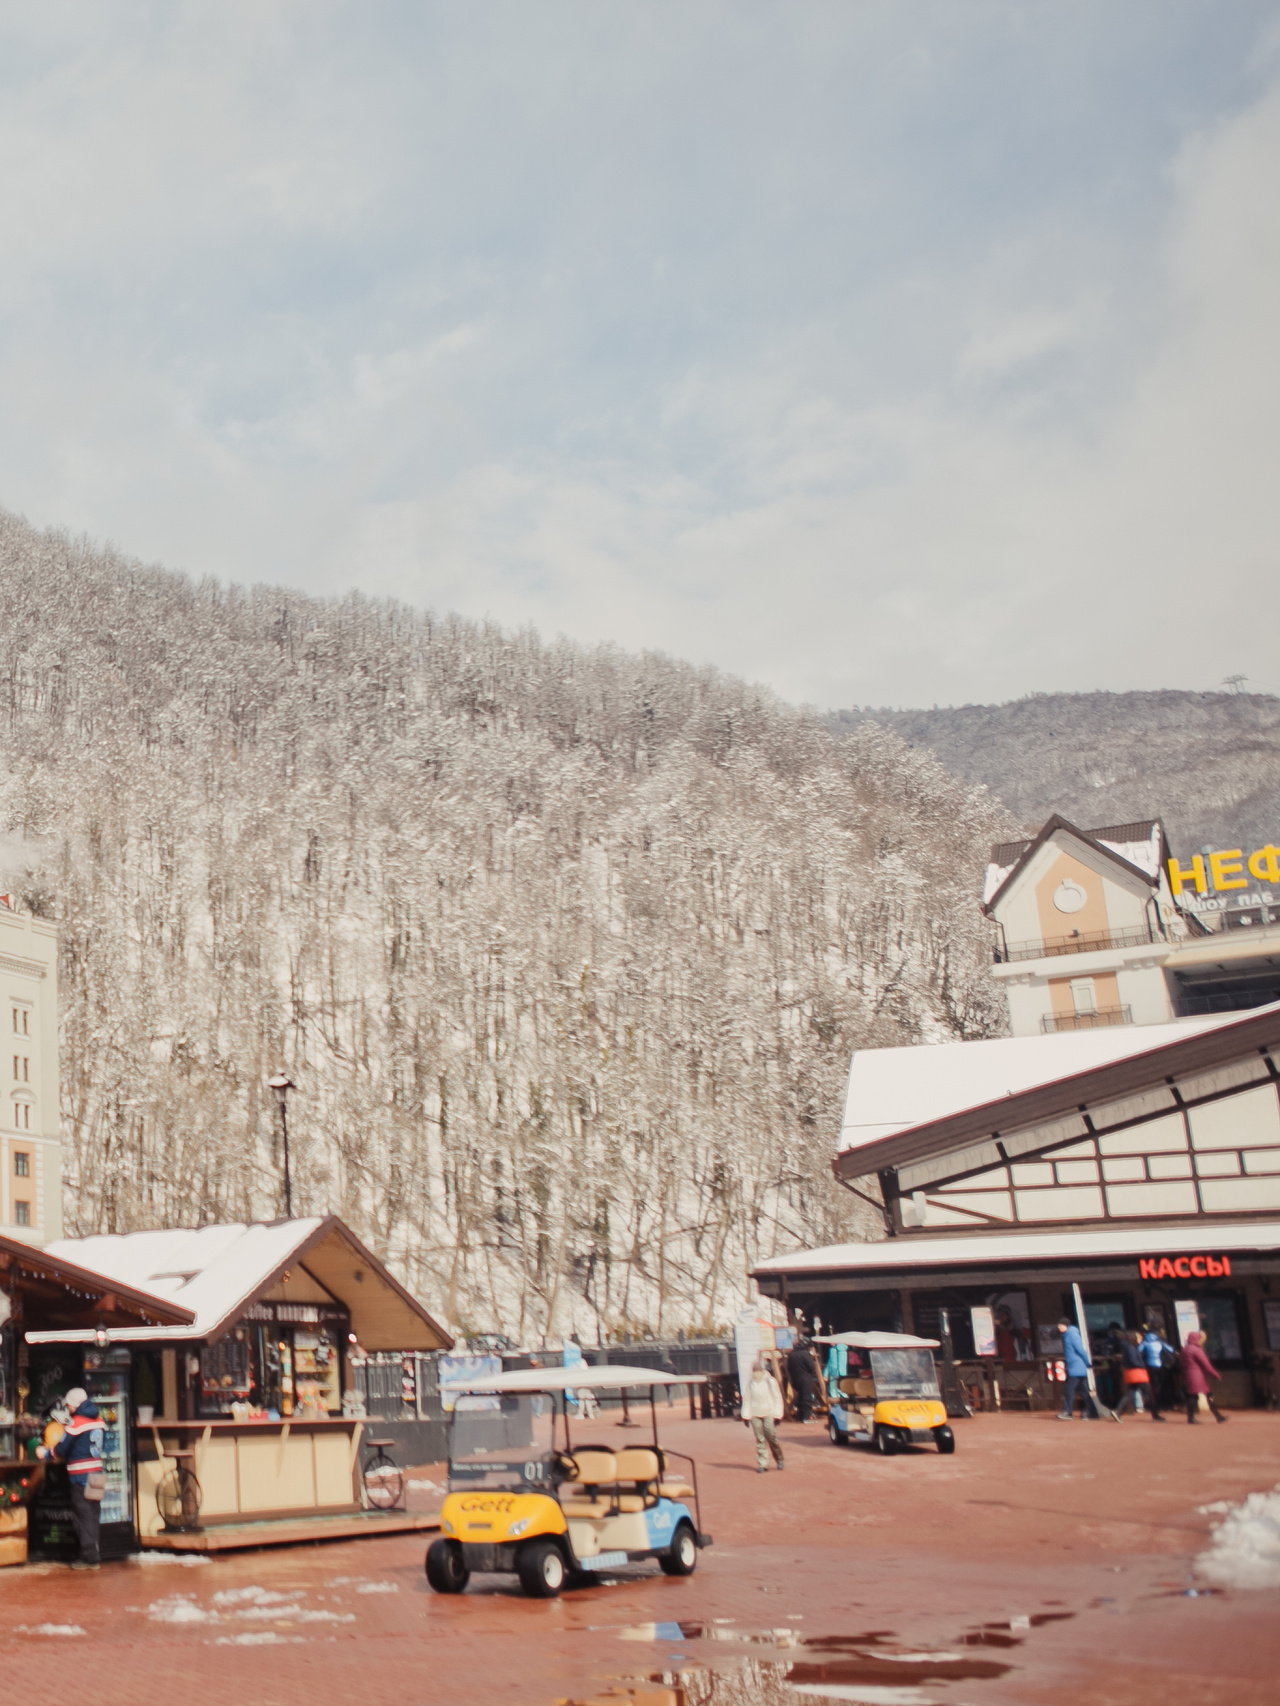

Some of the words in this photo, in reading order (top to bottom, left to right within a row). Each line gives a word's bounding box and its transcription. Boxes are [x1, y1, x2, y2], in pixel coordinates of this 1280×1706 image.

[1237, 891, 1274, 906] ПАБ
[1140, 1256, 1231, 1279] КАССЫ
[524, 1461, 544, 1480] 01
[460, 1497, 514, 1513] Gett
